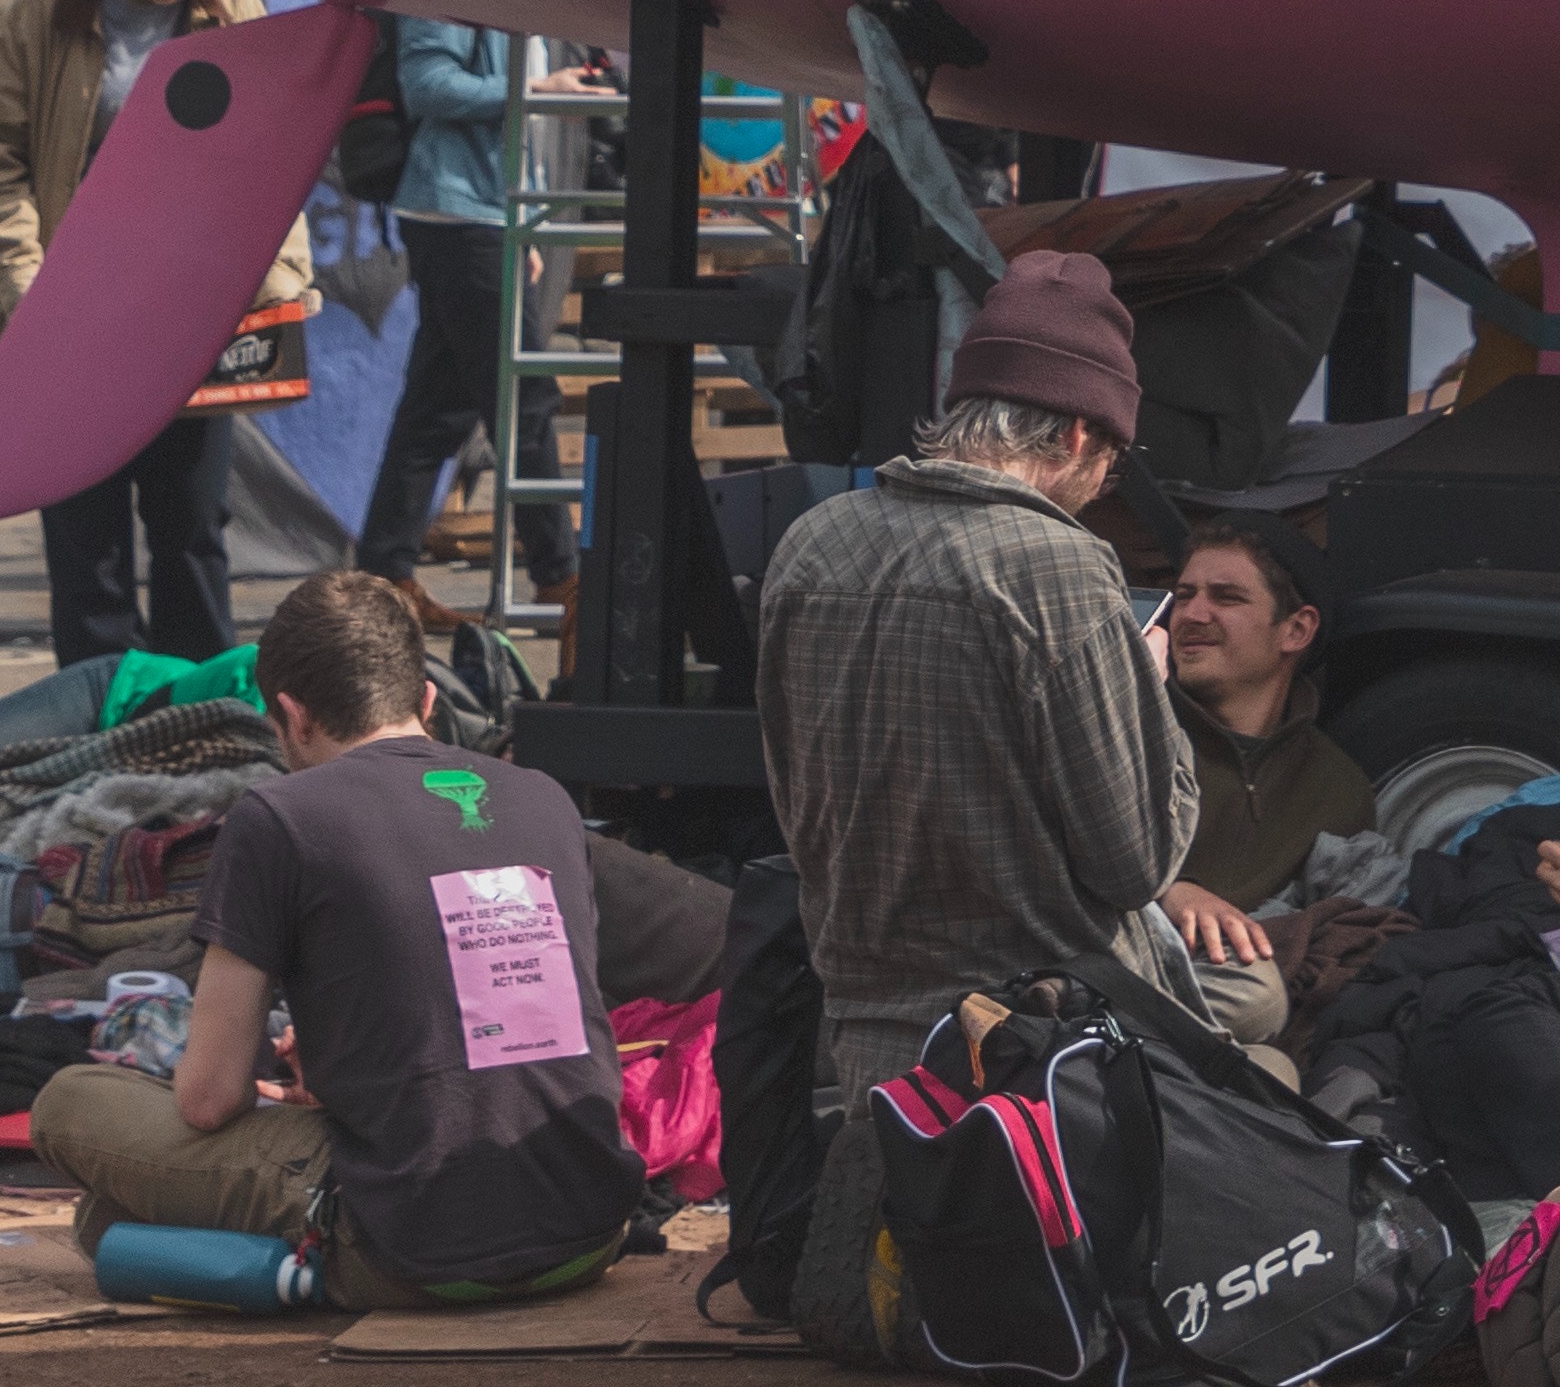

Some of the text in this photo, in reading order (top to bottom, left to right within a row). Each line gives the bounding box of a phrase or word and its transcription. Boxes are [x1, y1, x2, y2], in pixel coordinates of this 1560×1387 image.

[477, 908, 490, 919] BE
[459, 926, 473, 937] BY
[457, 938, 487, 951] WHO
[489, 936, 506, 947] DO
[490, 958, 540, 973] WE MUST
[492, 976, 513, 988] ACT
